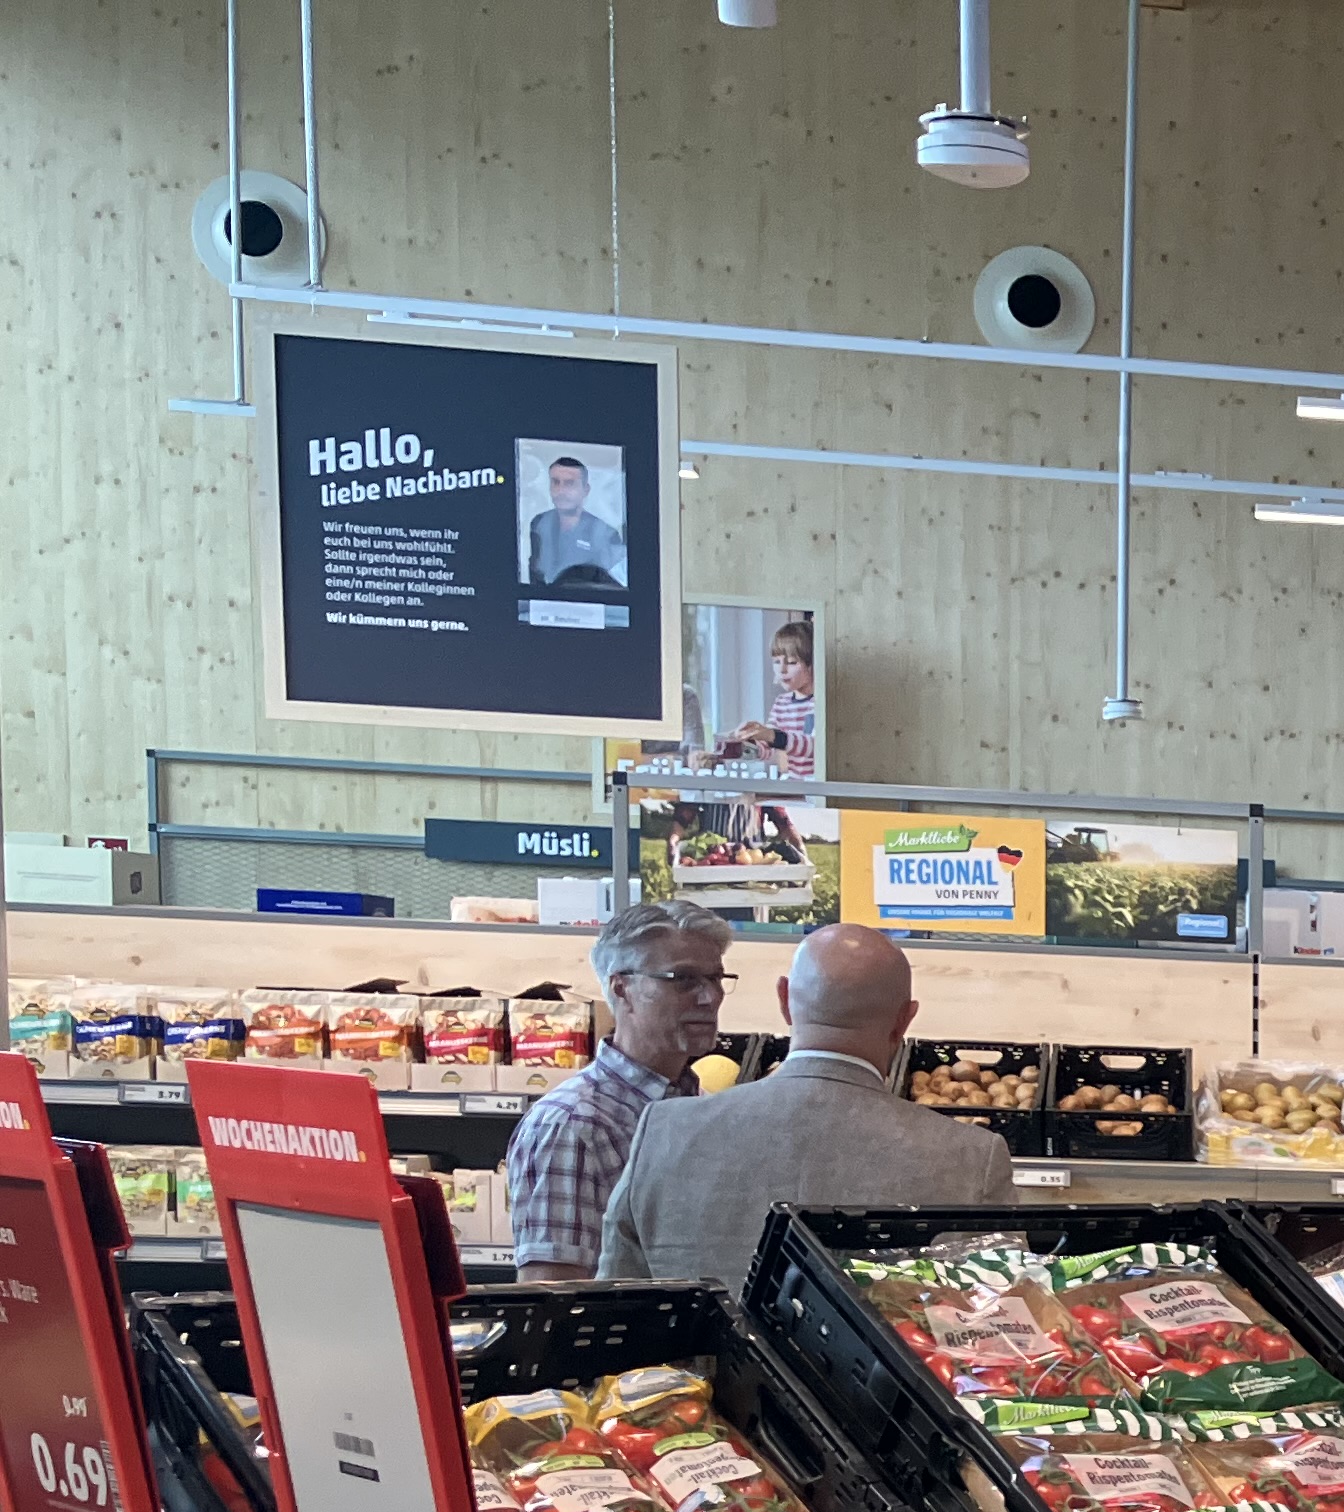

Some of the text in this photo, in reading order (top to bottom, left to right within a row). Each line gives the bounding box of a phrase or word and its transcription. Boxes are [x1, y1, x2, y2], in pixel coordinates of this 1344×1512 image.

[309, 427, 434, 476] Hallo,
[321, 468, 505, 507] liebe Nachbarn.
[323, 521, 460, 541] Wir freuen uns, wenn ihr
[323, 537, 351, 547] euch
[353, 538, 372, 548] bei
[373, 541, 394, 550] uns
[324, 549, 358, 561] Sollte
[359, 551, 419, 565] irgendwas
[324, 563, 455, 581] dann sprecht mich oder
[325, 577, 476, 597] eine/n meiner Kolleginnen
[326, 591, 352, 602] oder
[354, 593, 405, 607] Kollegen
[326, 612, 348, 624] Wir
[349, 614, 407, 628] kümmern
[408, 620, 430, 630] uns
[517, 831, 600, 857] Müsli.
[889, 830, 960, 849] Marktliebe
[889, 857, 1000, 887] REGIONAL
[937, 888, 1000, 902] VON PENNY
[208, 1116, 367, 1163] WOCHENAKTION.
[1149, 1285, 1203, 1306] Cocktail-
[30, 1432, 110, 1507] 0.69
[1094, 1457, 1151, 1471] Cocktail-
